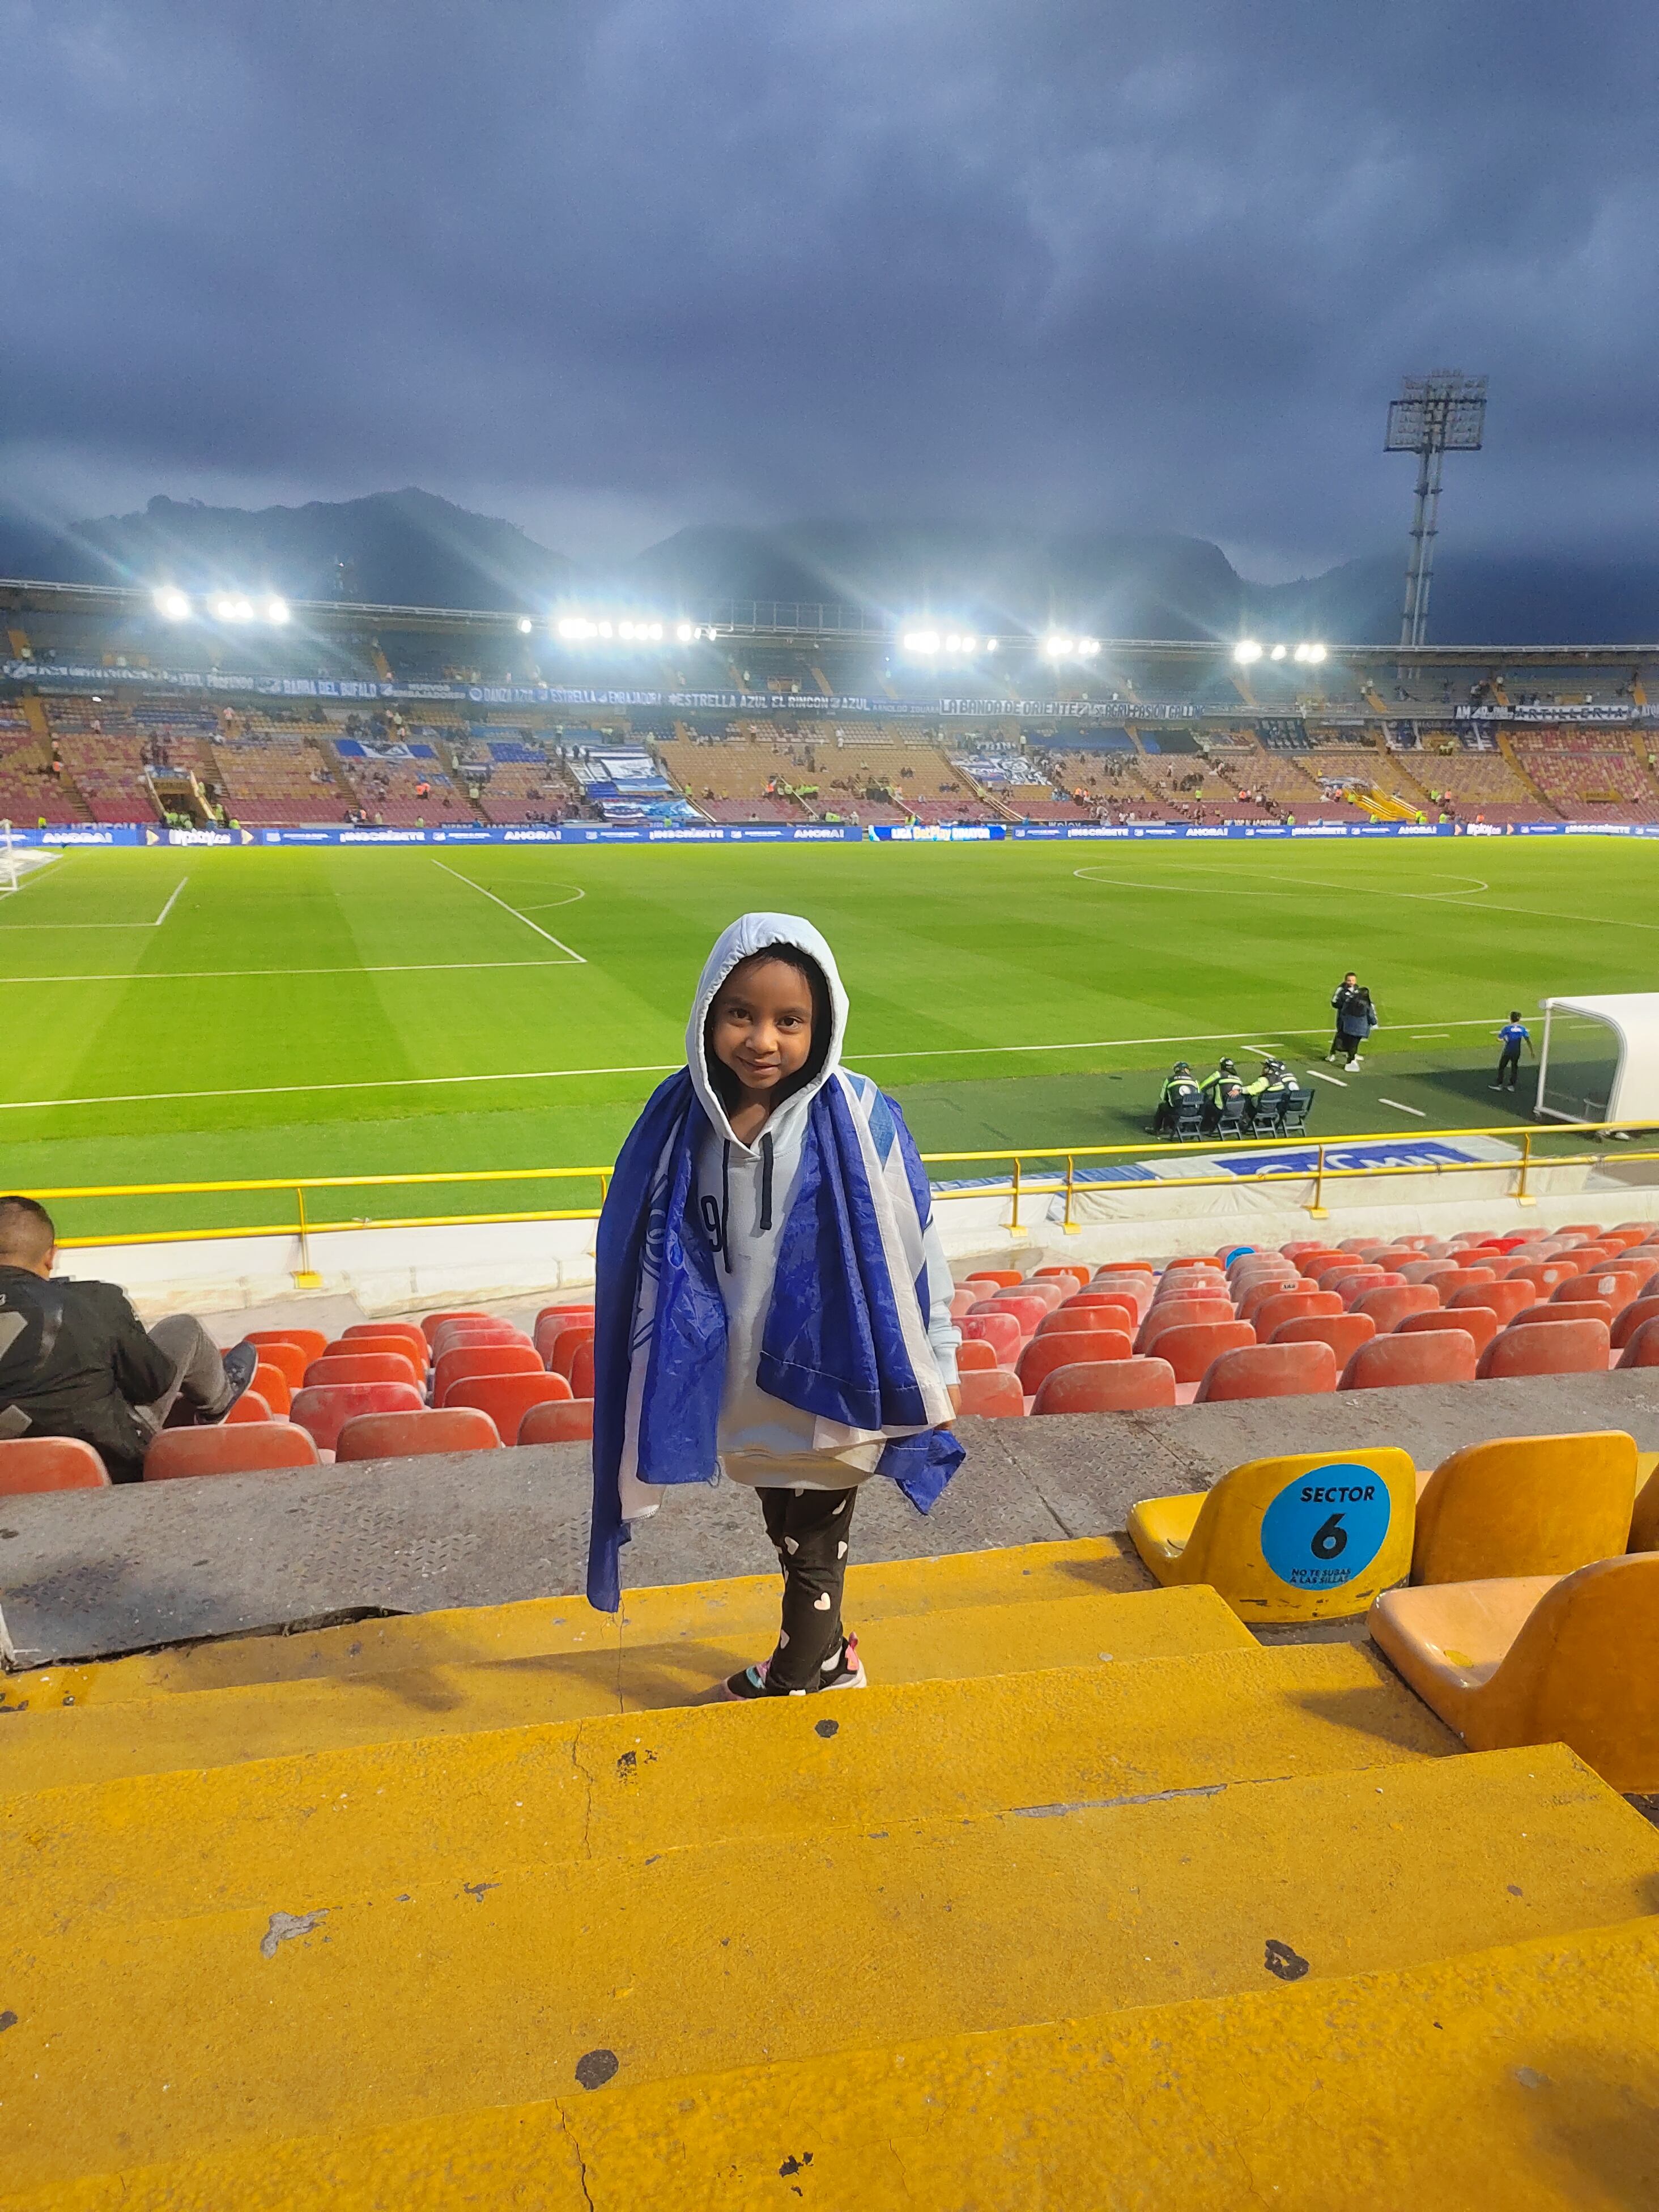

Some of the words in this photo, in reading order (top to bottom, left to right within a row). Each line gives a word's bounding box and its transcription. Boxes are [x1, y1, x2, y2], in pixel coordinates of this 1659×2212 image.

[678, 694, 736, 707] ESTRELLA
[739, 696, 767, 708] AZUL
[771, 696, 785, 708] EL
[842, 698, 870, 711] AZUL
[942, 700, 956, 713] LA
[959, 700, 1002, 714] BANDA
[1005, 701, 1020, 714] DE
[1023, 701, 1077, 715] ORIENTE
[1516, 707, 1624, 720] ARTILLERIA
[504, 831, 561, 840] AHORA!
[794, 829, 844, 838] AHORA!
[891, 828, 911, 839] LIGA
[913, 825, 951, 840] BetPlay
[952, 828, 990, 839] DIMAYOR
[1300, 1486, 1375, 1503] SECTOR
[1311, 1513, 1347, 1559] 6
